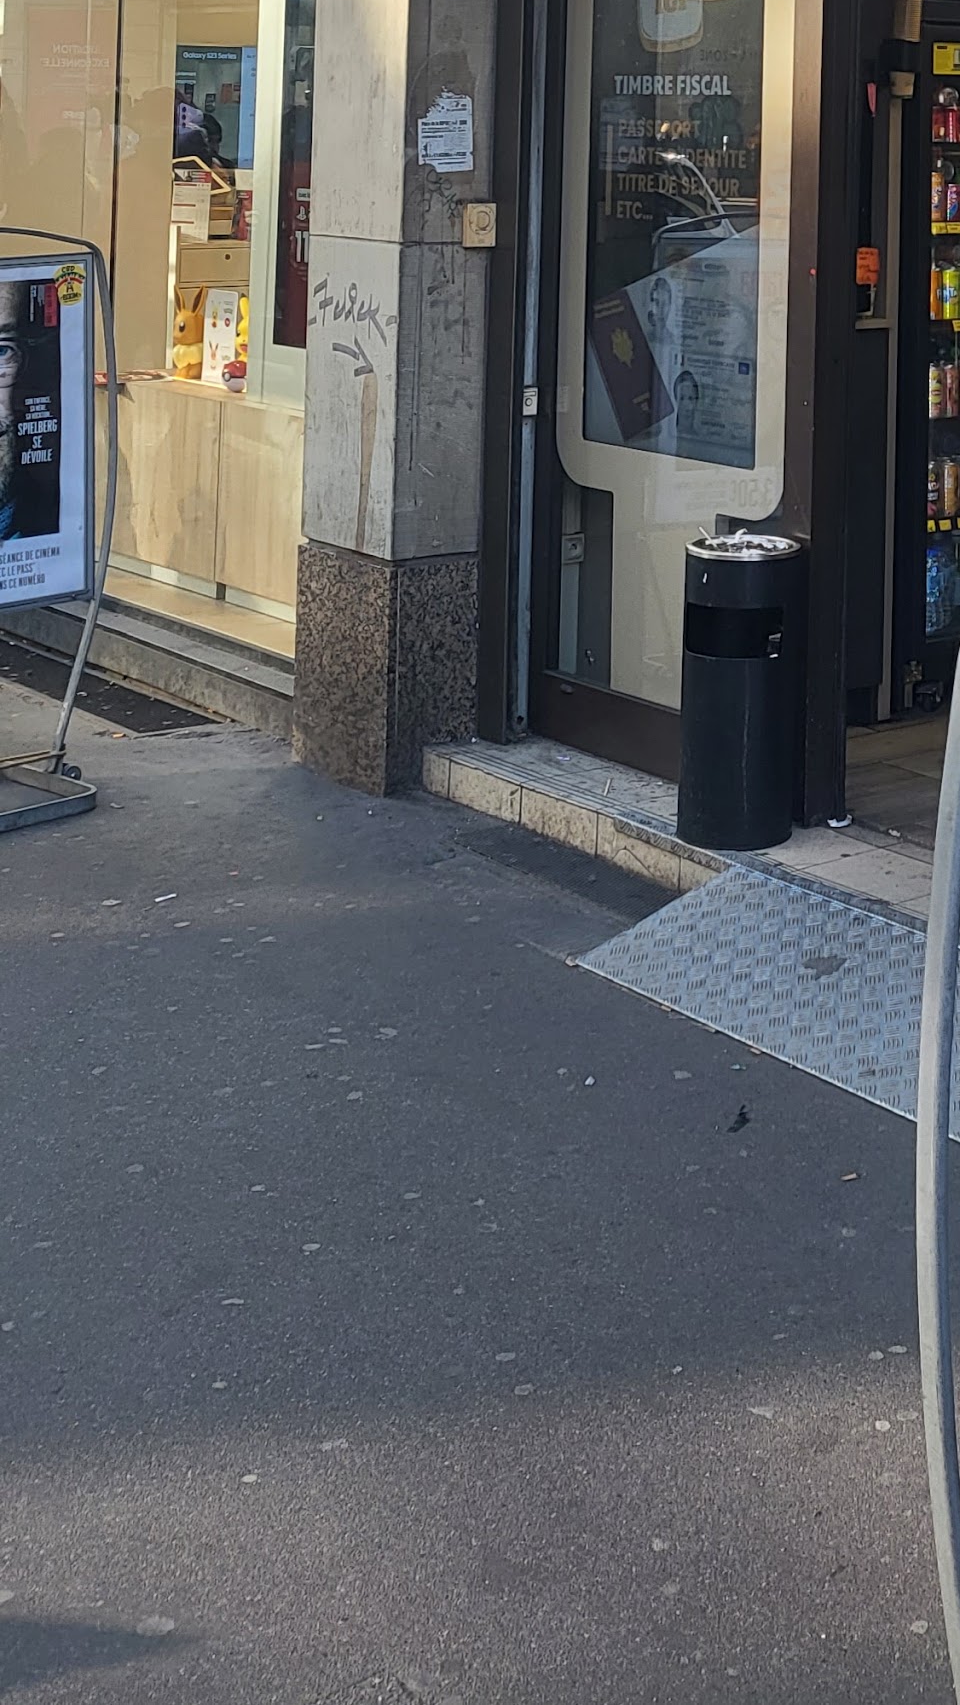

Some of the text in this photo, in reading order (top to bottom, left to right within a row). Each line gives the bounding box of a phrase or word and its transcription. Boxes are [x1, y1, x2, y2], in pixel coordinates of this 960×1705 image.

[183, 51, 207, 60] Galaxy
[218, 52, 237, 60] Series
[614, 74, 732, 96] TIMBRE FISCAL
[617, 147, 665, 166] CARTE
[617, 173, 656, 193] TITRE
[658, 174, 679, 196] DE
[616, 201, 654, 220] ETC...
[17, 419, 58, 437] SPIELBERG
[32, 435, 43, 449] SE
[21, 449, 53, 465] DÉVOILE
[0, 546, 60, 565] SÉANCE DE CINÉMA
[7, 565, 16, 577] LE
[8, 573, 46, 589] CE NUMÉRO
